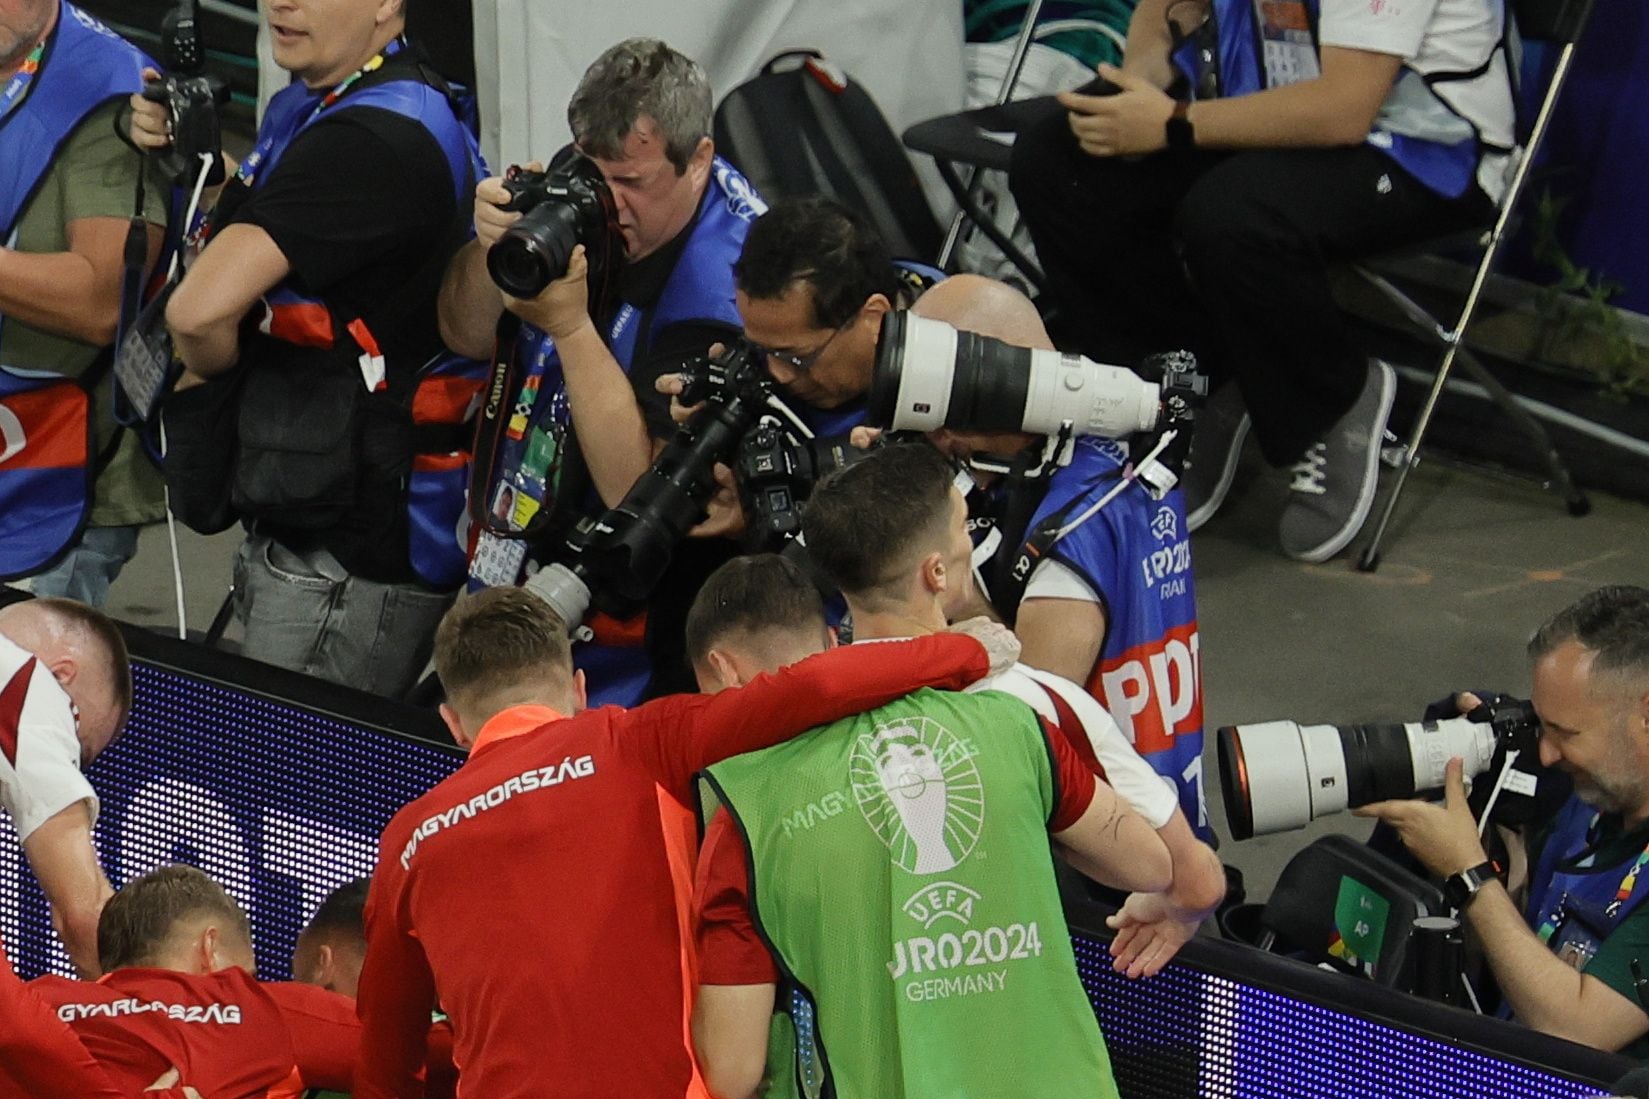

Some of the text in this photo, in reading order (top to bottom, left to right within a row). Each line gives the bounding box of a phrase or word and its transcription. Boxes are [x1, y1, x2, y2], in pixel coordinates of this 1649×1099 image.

[485, 362, 507, 420] Canon
[398, 754, 596, 871] MAGYARORSZÁG
[908, 889, 974, 922] UEFA
[905, 968, 1008, 1003] GERMANY
